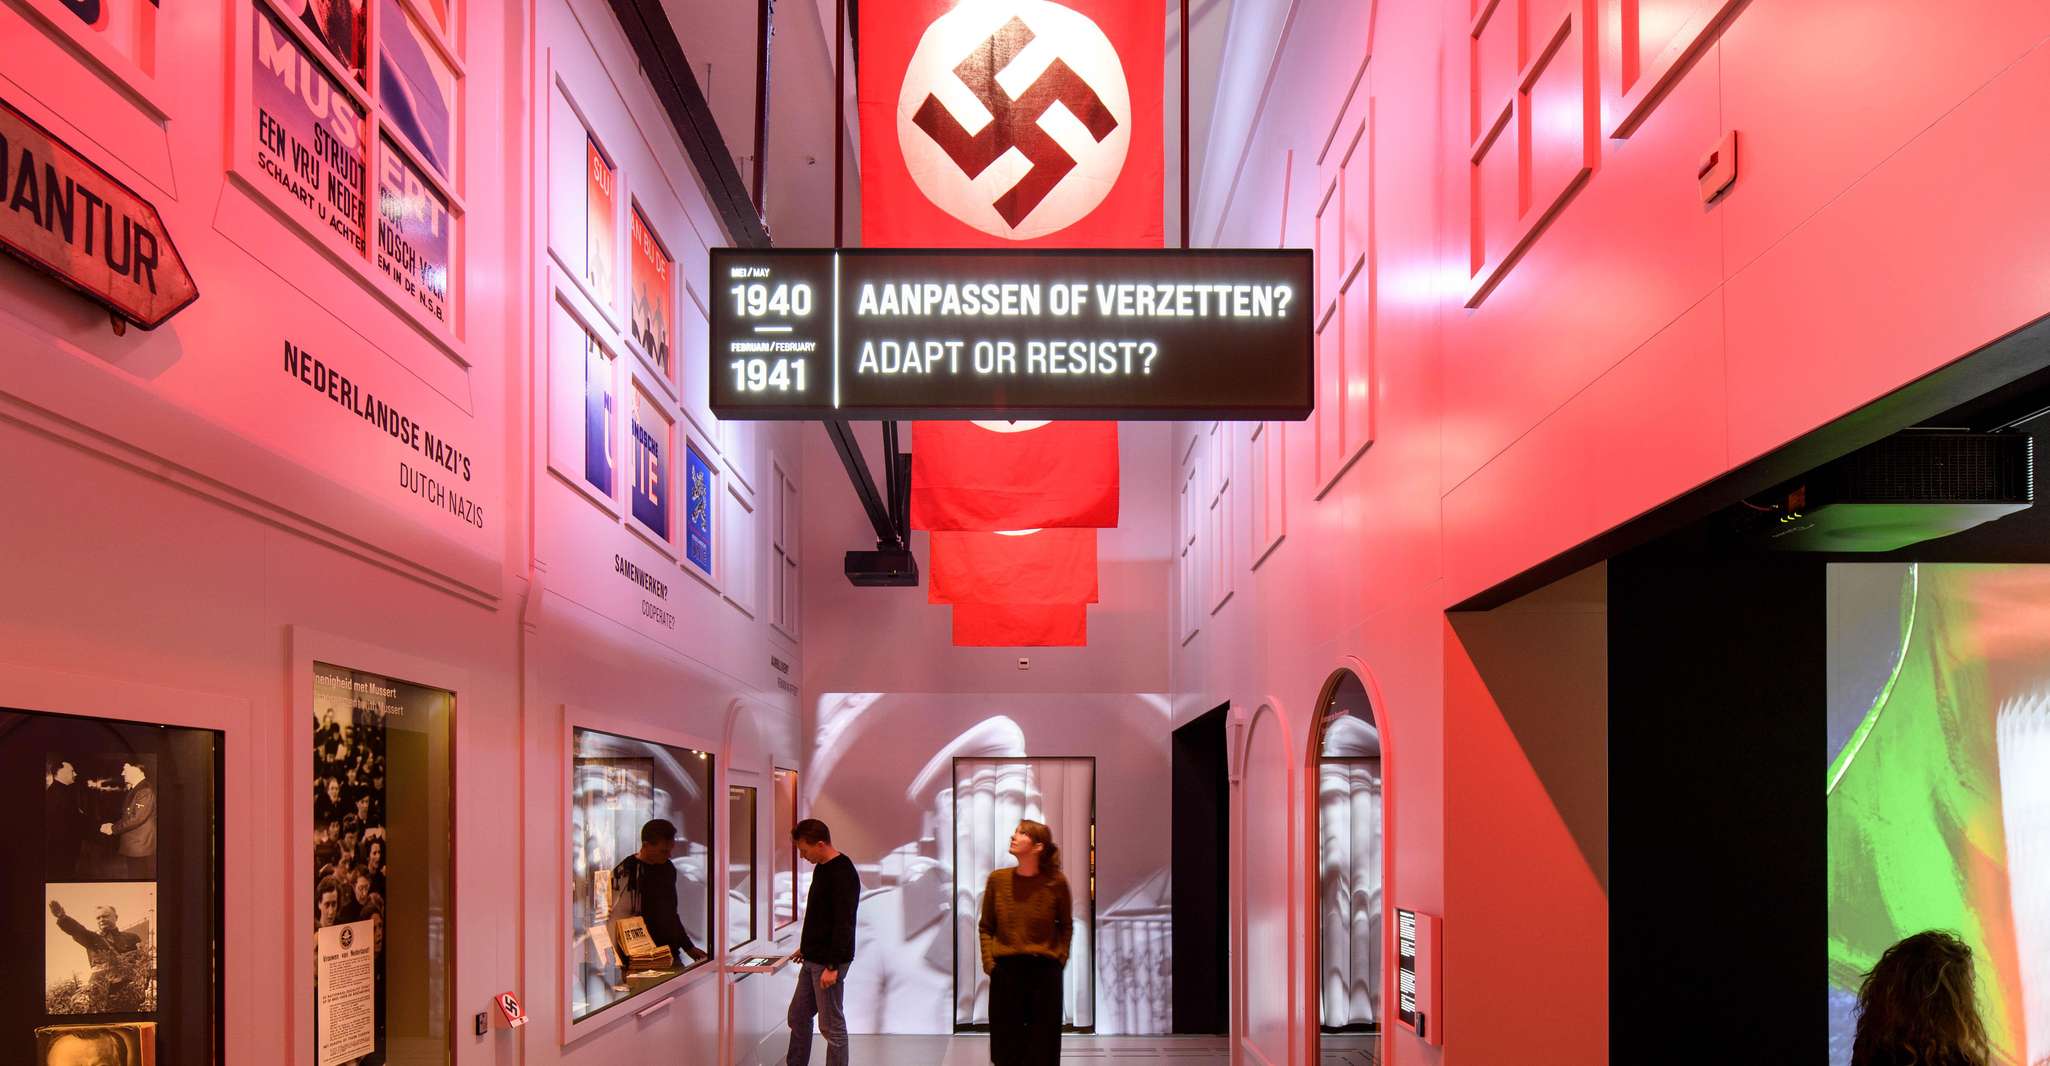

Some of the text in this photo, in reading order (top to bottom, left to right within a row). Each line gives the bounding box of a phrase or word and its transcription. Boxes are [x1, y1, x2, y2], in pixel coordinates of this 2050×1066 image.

[259, 107, 286, 161] EEN
[291, 137, 320, 190] VRIJ
[258, 151, 315, 210] SCHAART
[318, 202, 326, 220] U
[393, 268, 402, 286] IN
[405, 279, 416, 297] DE
[419, 290, 445, 322] N.S.B.
[731, 284, 812, 316] 1940
[858, 283, 1292, 317] AANPASSEN OF VERZETTEN?
[731, 359, 806, 392] 1941
[858, 341, 1158, 375] ADAPT OR RESIST?
[284, 340, 471, 482] NEDERLANDSE NAZI'S
[400, 462, 484, 529] DUTCH NAZIS
[615, 554, 668, 600] SAMENWERKEN?
[642, 600, 675, 630] COOPERATE?
